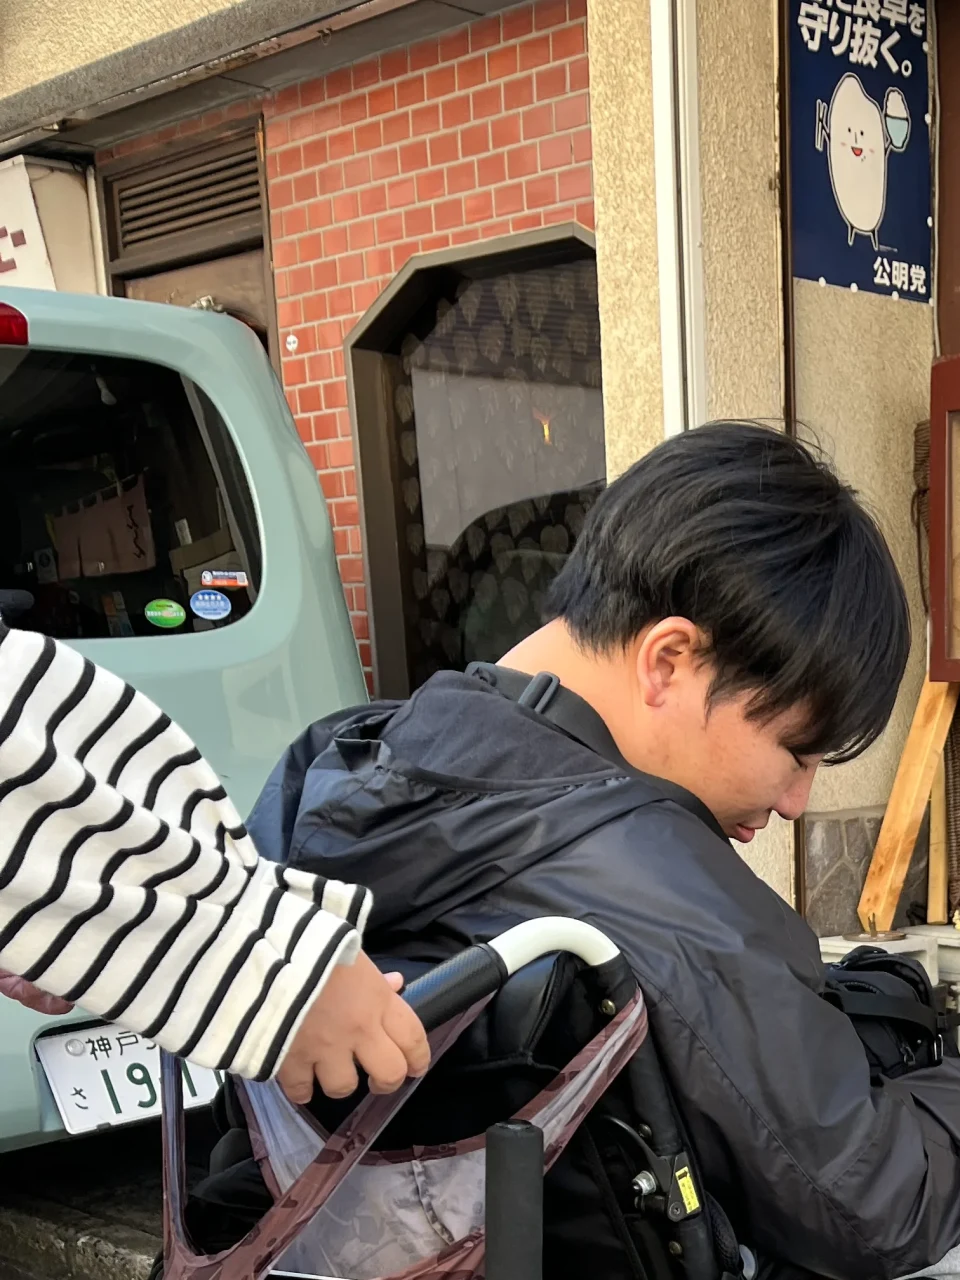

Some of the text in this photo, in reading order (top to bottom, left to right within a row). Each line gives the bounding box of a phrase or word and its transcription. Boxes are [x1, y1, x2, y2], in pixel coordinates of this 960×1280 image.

[797, 2, 913, 78] 守り抜く。
[873, 256, 927, 294] 公明党
[70, 1086, 89, 1110] さ
